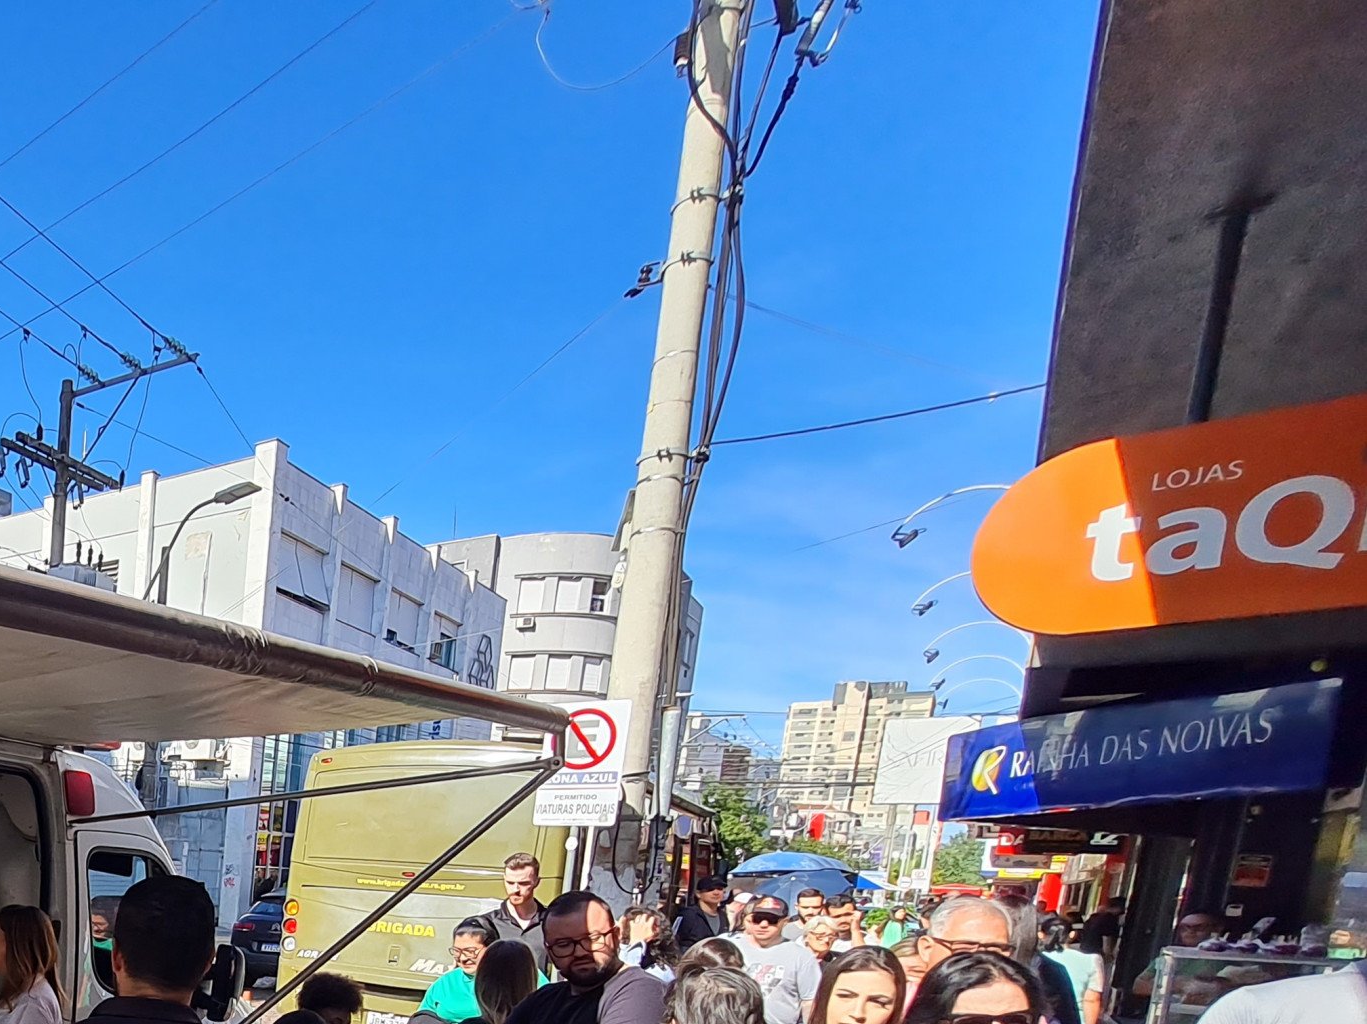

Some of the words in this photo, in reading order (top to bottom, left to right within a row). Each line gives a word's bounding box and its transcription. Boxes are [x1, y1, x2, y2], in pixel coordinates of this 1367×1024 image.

[1151, 460, 1245, 492] LOJAS
[1099, 729, 1152, 766] DAS
[1158, 708, 1275, 756] NOIVAS
[582, 773, 616, 783] AZUL
[536, 803, 574, 815] VIATURAS
[575, 803, 615, 815] POLICIAIS
